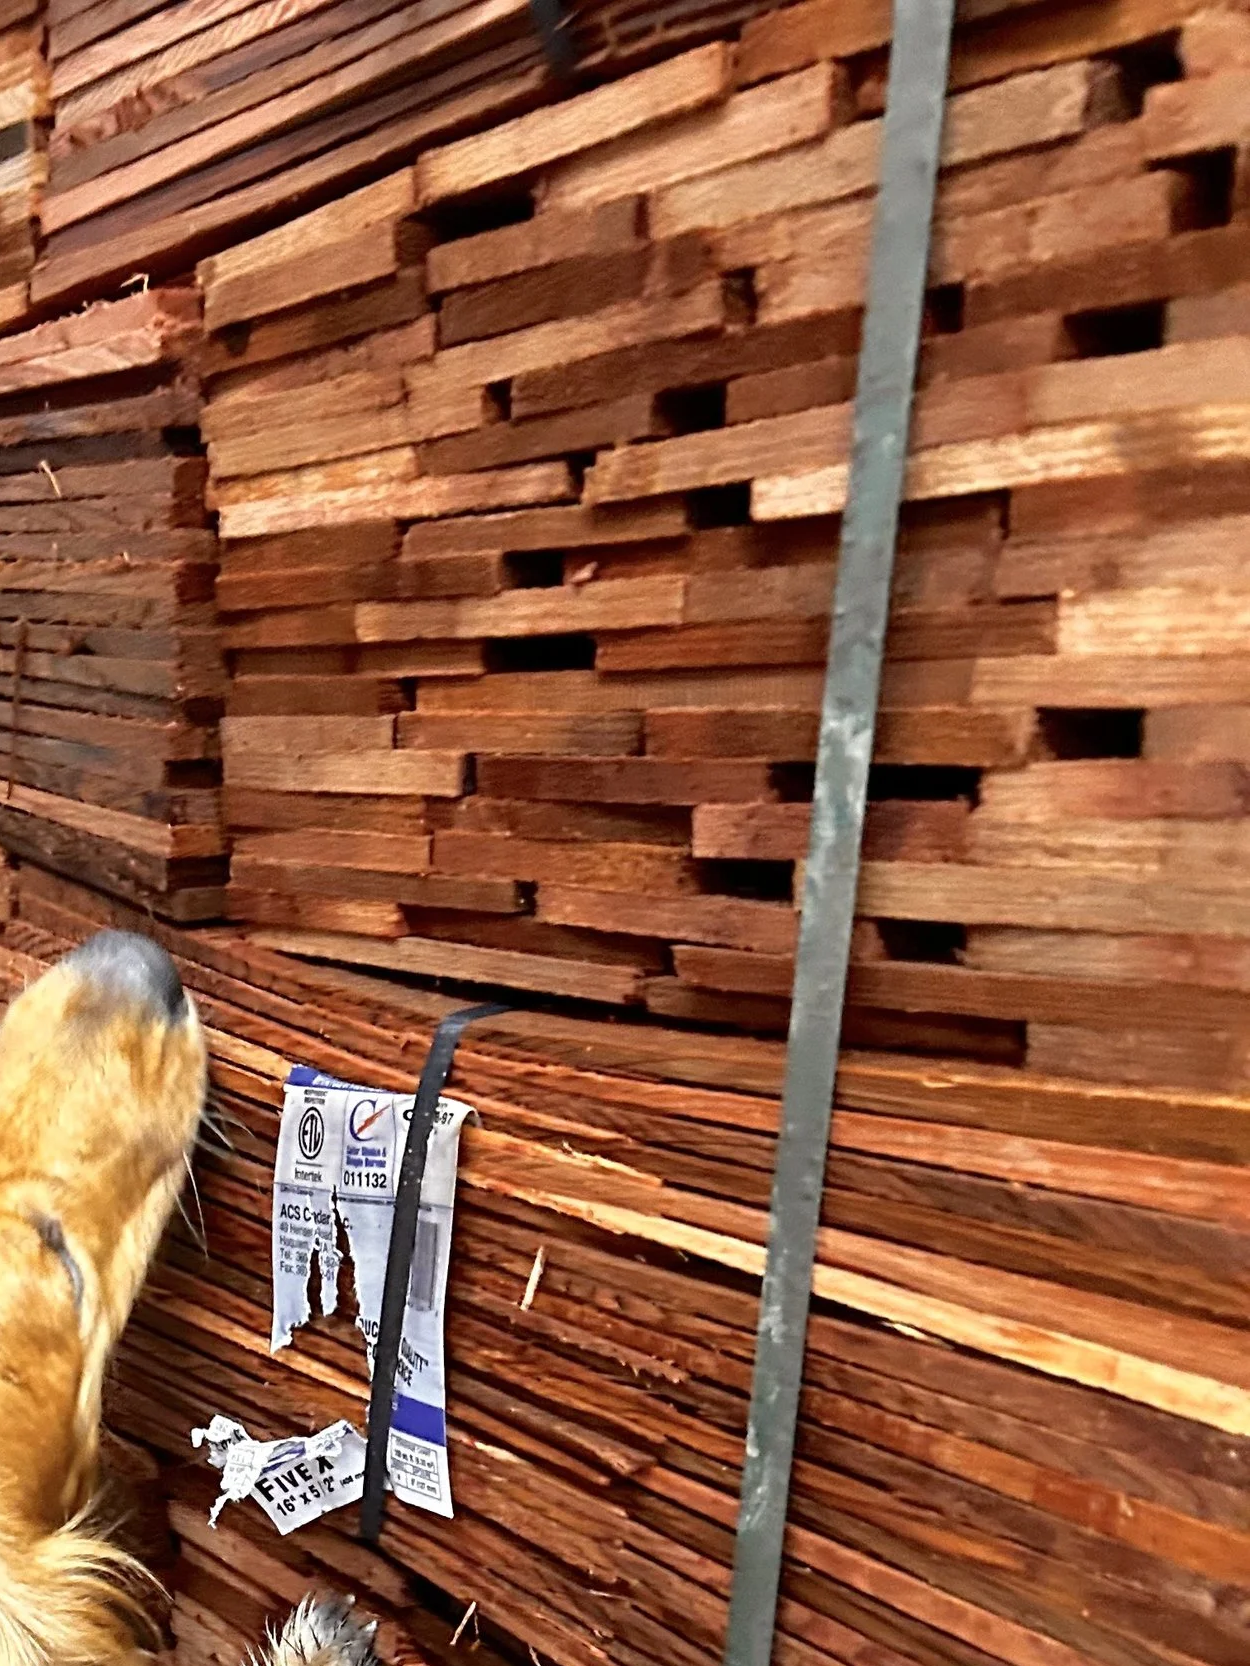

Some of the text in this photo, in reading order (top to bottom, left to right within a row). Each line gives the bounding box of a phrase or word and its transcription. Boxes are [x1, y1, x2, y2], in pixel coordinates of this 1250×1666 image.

[343, 1170, 387, 1189] 011132
[280, 1203, 301, 1220] ACS
[254, 1462, 313, 1502] FIVE
